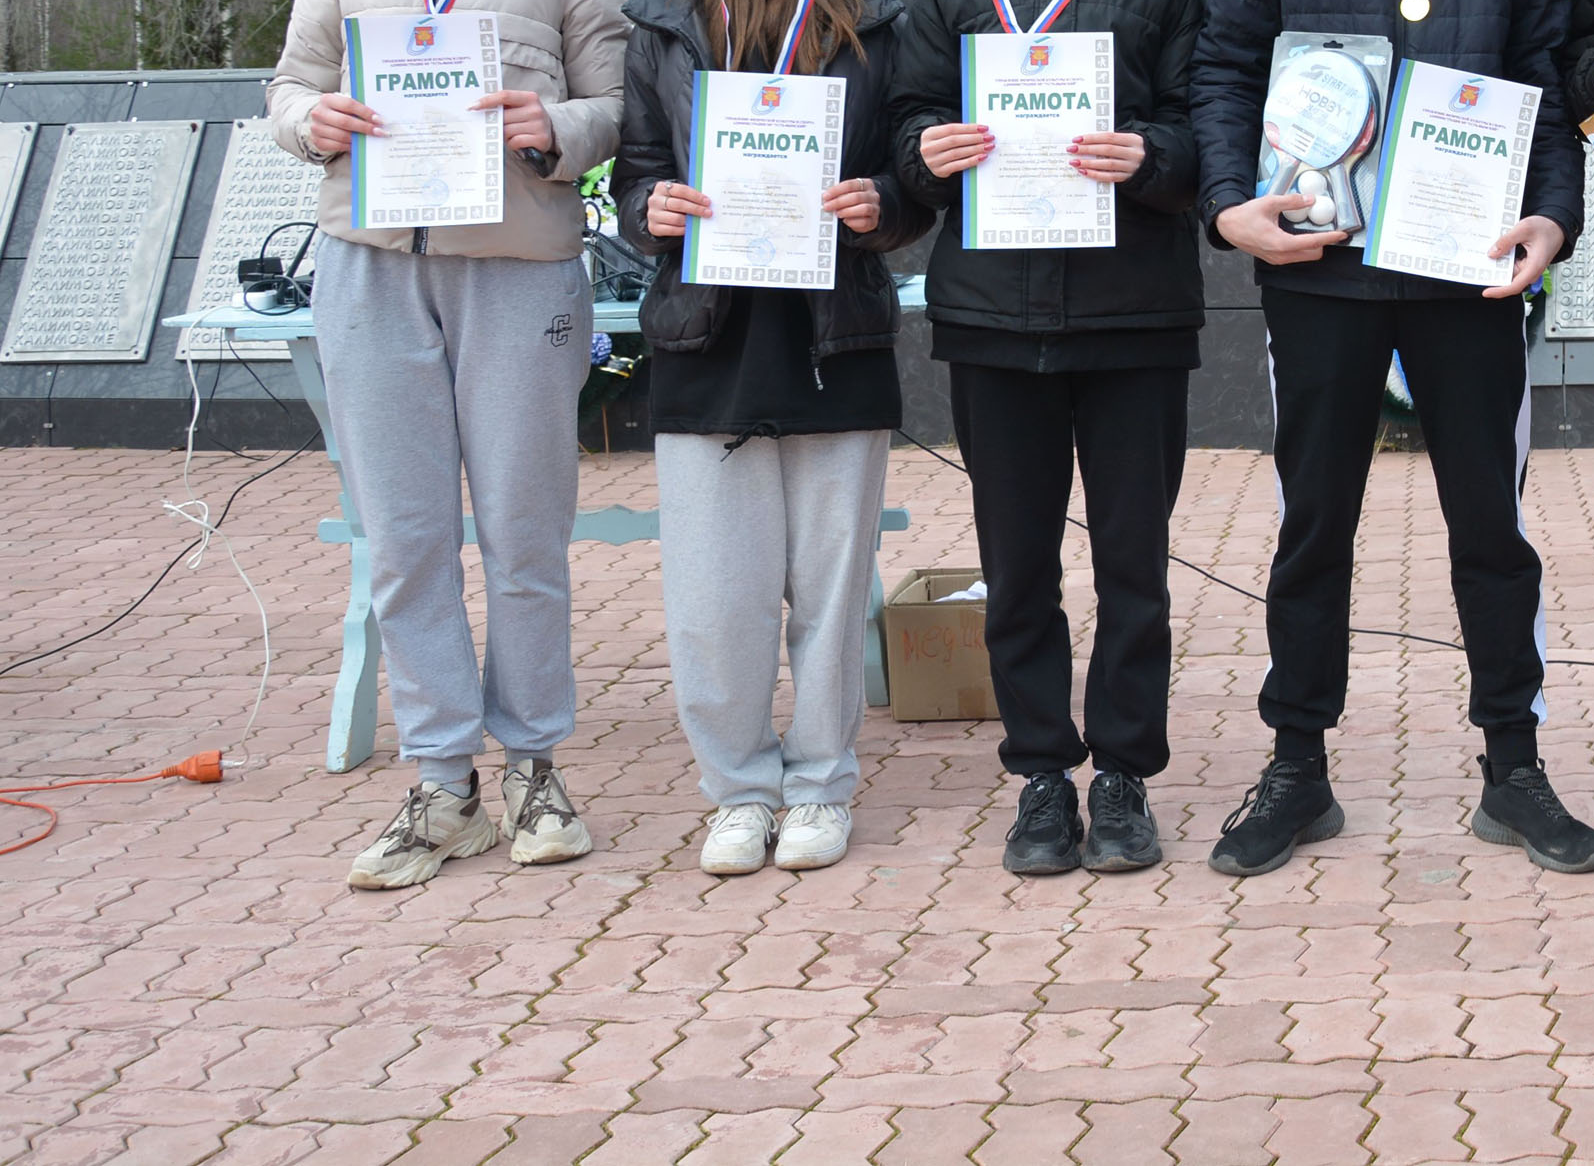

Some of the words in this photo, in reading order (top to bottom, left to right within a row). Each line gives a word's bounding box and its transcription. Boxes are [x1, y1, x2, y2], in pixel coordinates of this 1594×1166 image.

[376, 70, 480, 91] ГРАМОТА
[988, 92, 1092, 111] ГРАМОТА
[72, 134, 140, 146] КАЛИМОВ
[716, 130, 820, 153] ГРАМОТА
[1410, 121, 1509, 157] ГРАМОТА
[68, 147, 137, 158] КАЛИМОВ
[64, 160, 134, 172] КАЛИМОВ
[60, 173, 130, 184] КАЛИМОВ
[231, 170, 303, 181] КАЛИМОВ
[56, 186, 126, 198] КАЛИМОВ
[228, 183, 300, 194] КАЛИМОВ
[53, 200, 122, 211] КАЛИМОВ
[224, 196, 298, 208] КАЛИМОВ
[50, 213, 119, 224] КАЛИМОВ
[222, 210, 294, 221] КАЛИМОВ
[46, 226, 115, 238] КАЛИМОВ
[41, 240, 112, 251] КАЛИМОВ
[38, 253, 108, 264] КАЛИМОВ
[34, 266, 105, 278] КАЛИМОВ
[30, 280, 100, 291] КАЛИМОВ
[26, 293, 98, 304] КАЛИМОВ
[22, 306, 94, 318] КАЛИМОВ
[18, 320, 90, 332] КАЛИМОВ
[14, 334, 87, 346] КАЛИМОВ
